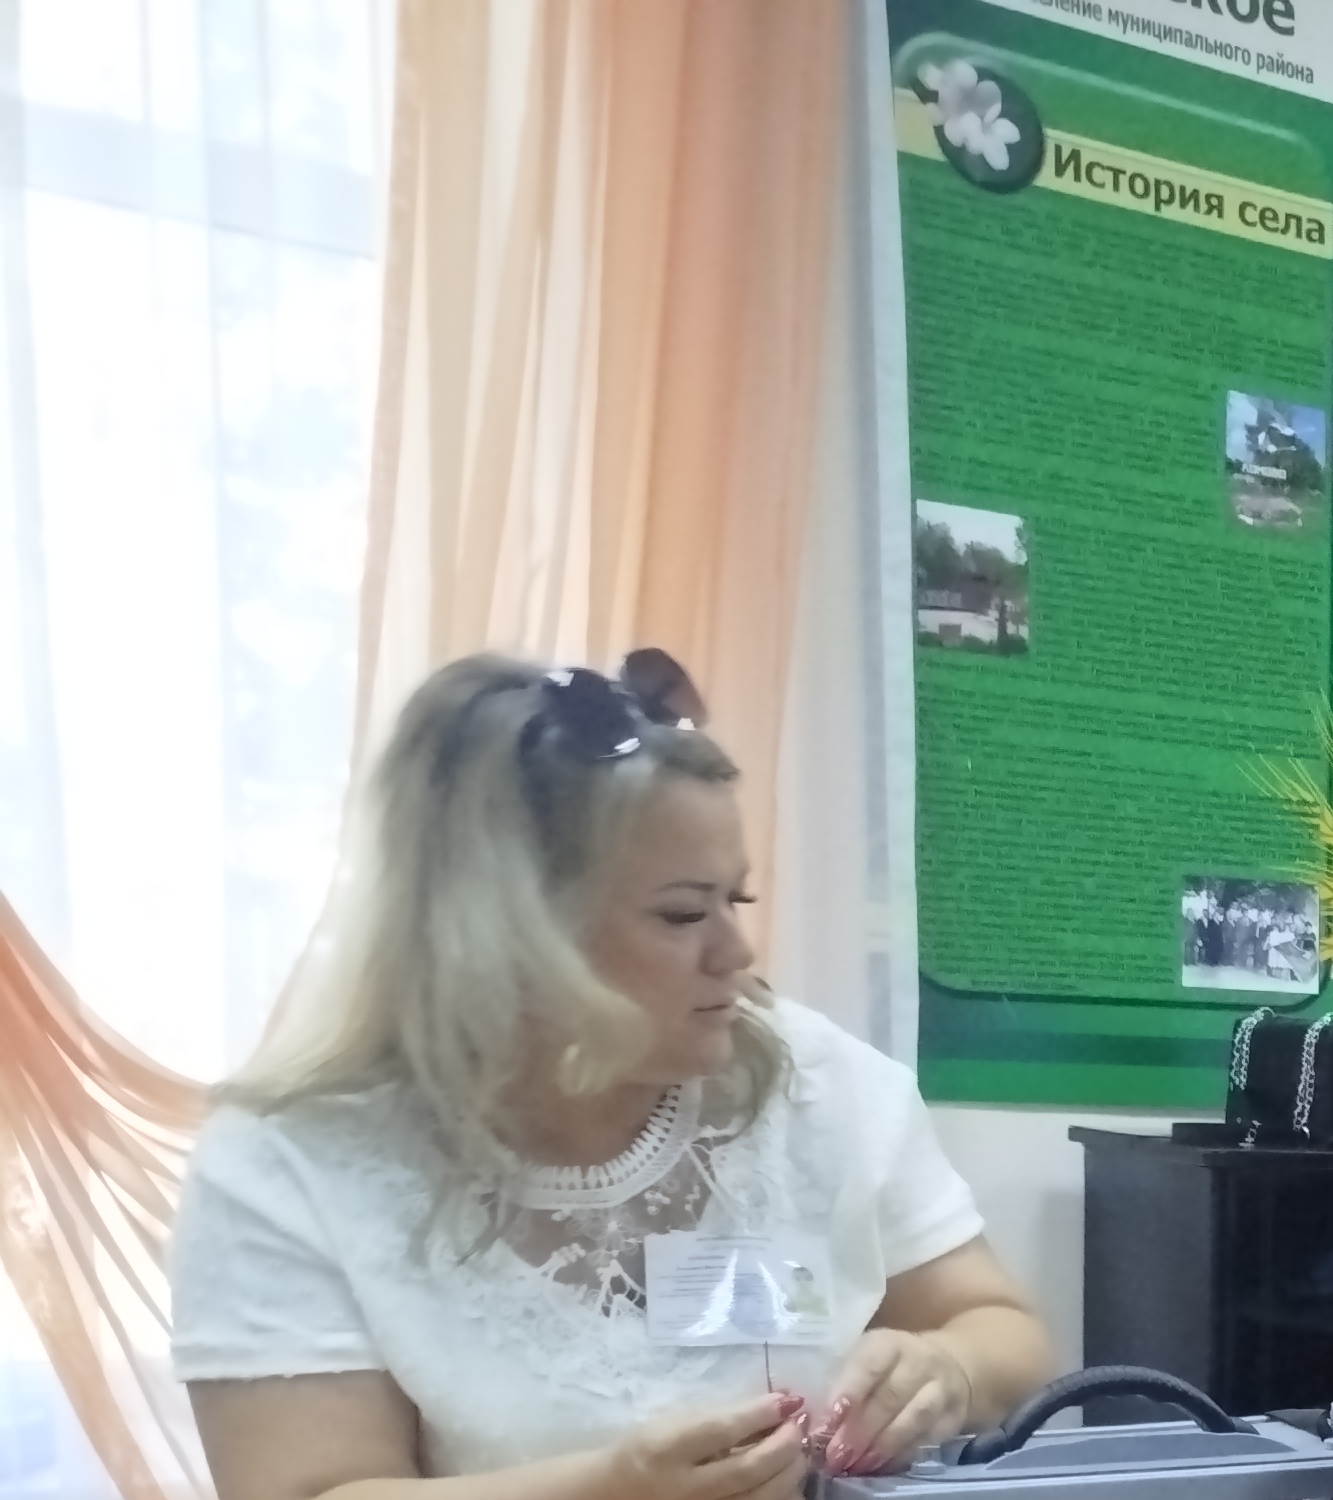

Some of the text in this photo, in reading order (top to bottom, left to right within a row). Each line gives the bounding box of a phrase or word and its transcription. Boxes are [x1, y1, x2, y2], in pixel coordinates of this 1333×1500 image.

[1107, 7, 1251, 66] муниципального
[1256, 52, 1315, 84] района
[1052, 142, 1327, 245] История села
